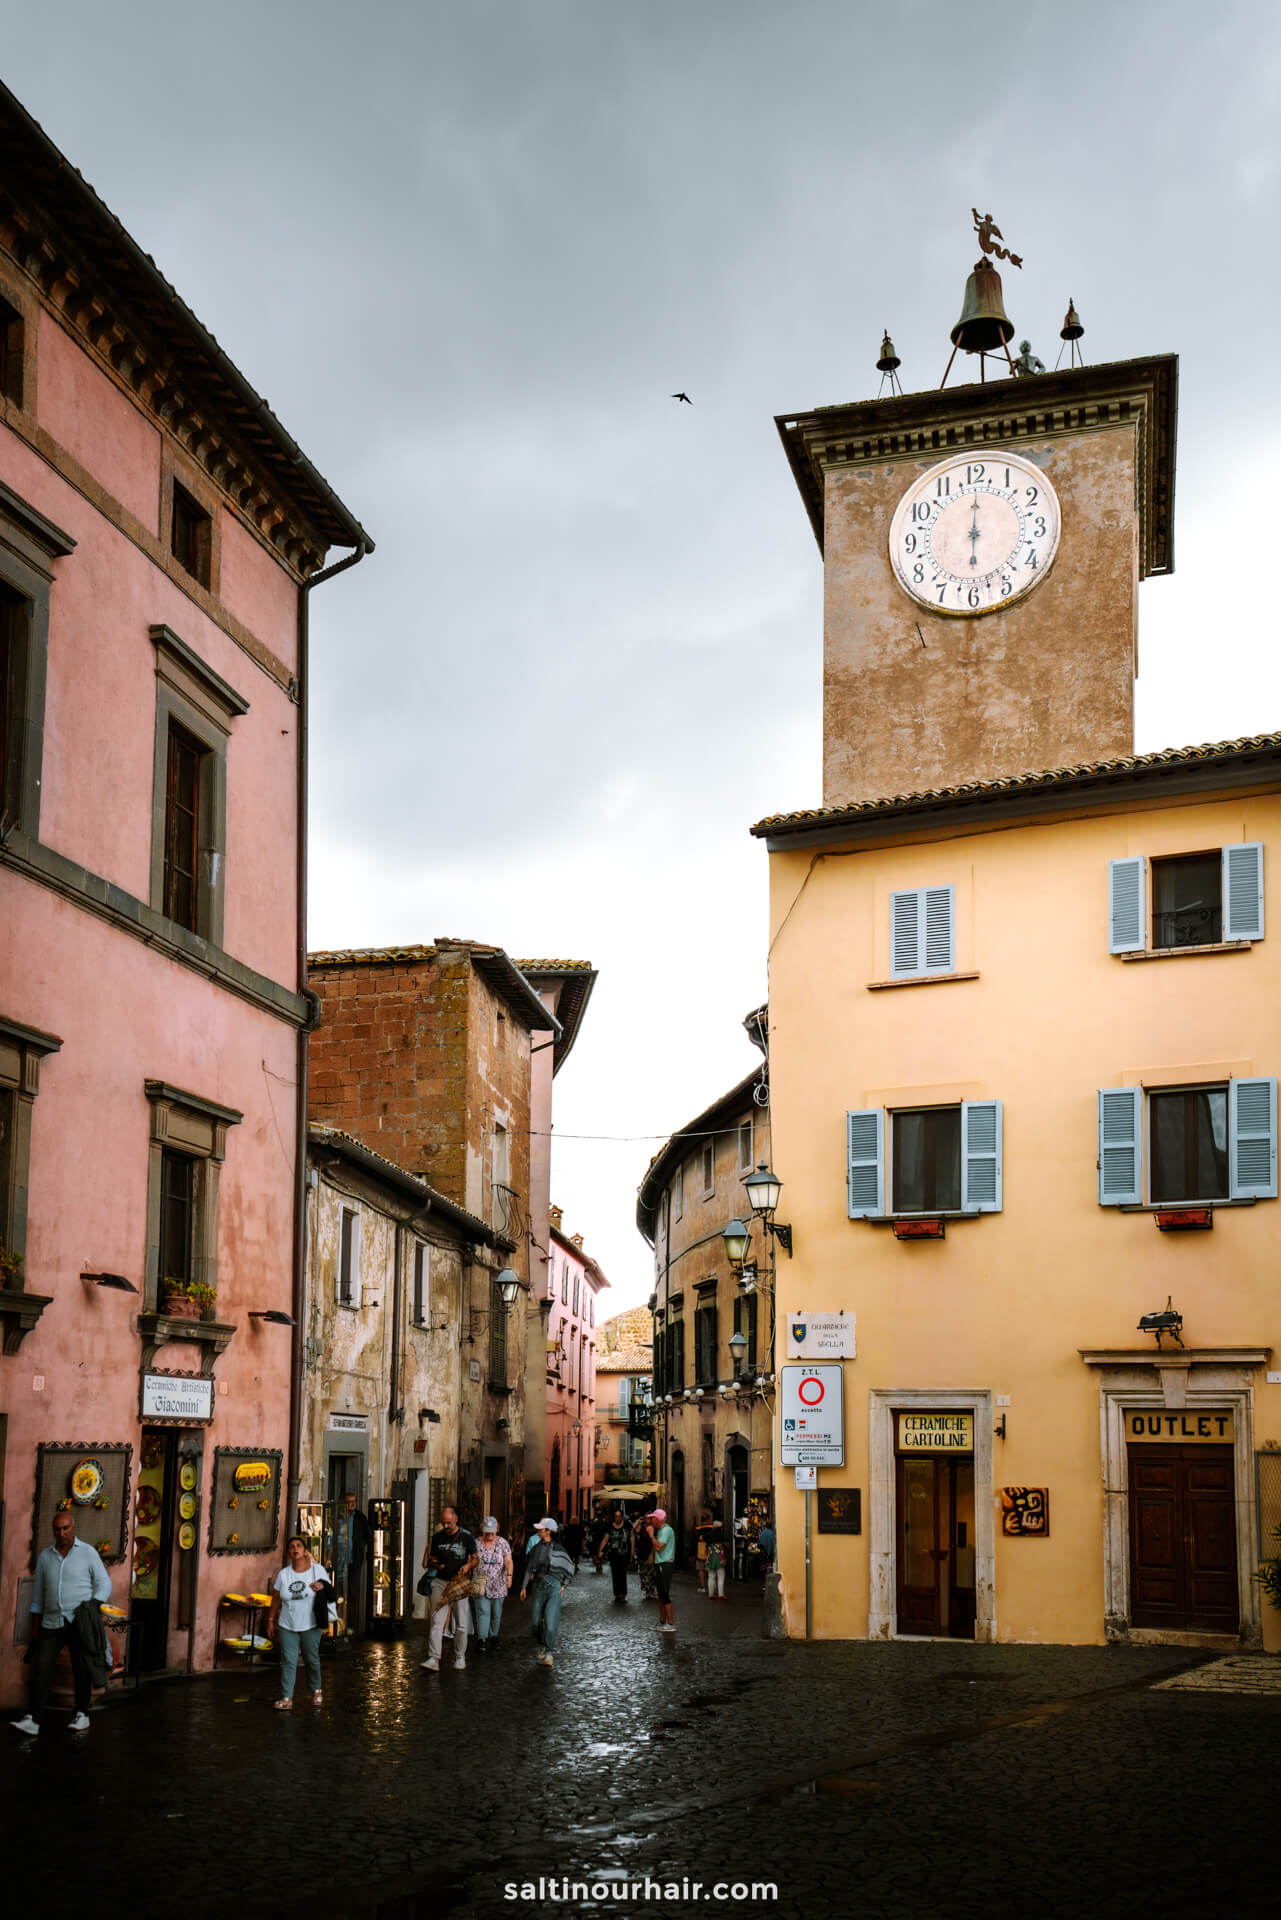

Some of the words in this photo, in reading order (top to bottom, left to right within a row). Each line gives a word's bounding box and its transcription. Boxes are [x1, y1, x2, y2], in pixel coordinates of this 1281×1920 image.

[966, 464, 985, 485] 12
[1005, 467, 1010, 488] 1
[937, 476, 950, 497] 11
[1025, 486, 1038, 507] 2
[912, 501, 931, 522] 10
[1034, 516, 1046, 537] 3
[905, 533, 917, 553] 9
[1024, 548, 1039, 569] 4
[913, 563, 924, 583] 8
[935, 583, 947, 603] 7
[1001, 575, 1012, 595] 5
[968, 586, 979, 607] 6
[146, 1377, 177, 1391] Ceramiche
[905, 1416, 968, 1430] CERAMICHE
[1132, 1416, 1228, 1437] OUTLET
[905, 1432, 968, 1446] CARTOLINE
